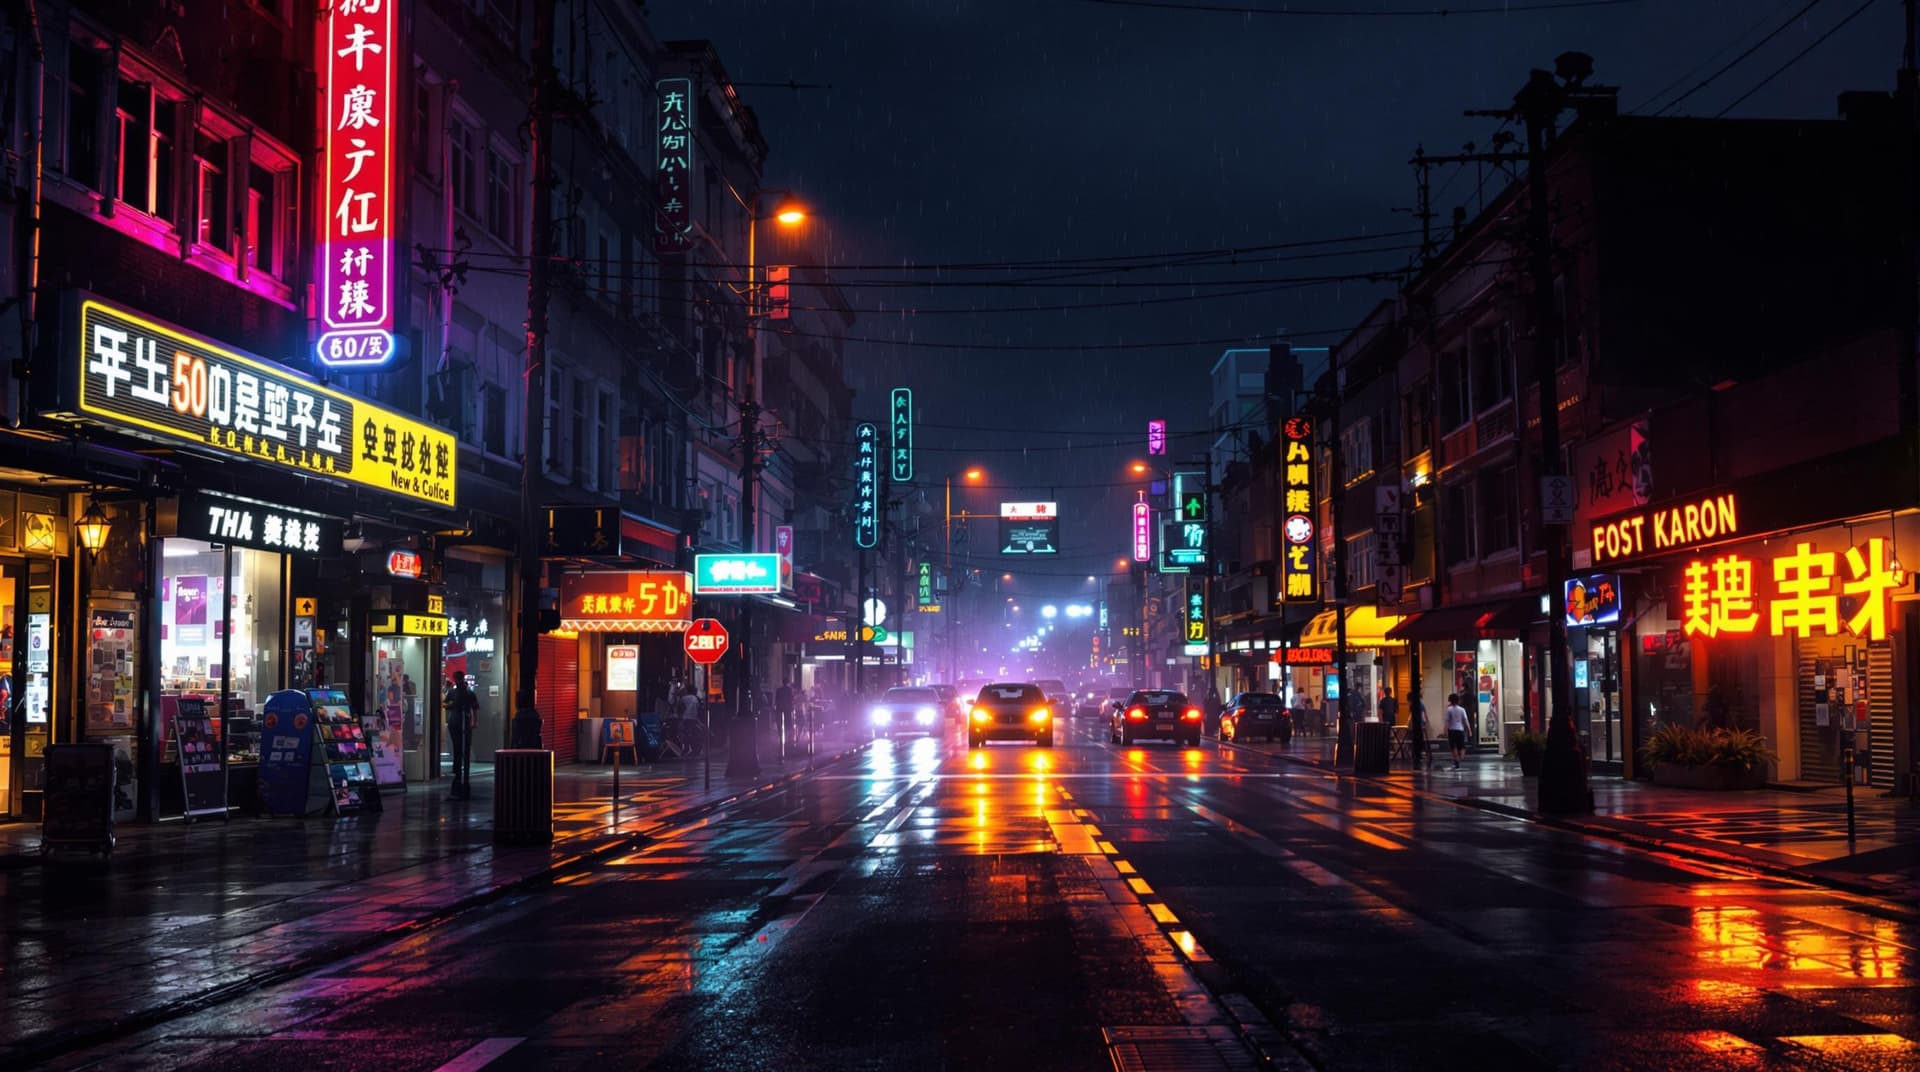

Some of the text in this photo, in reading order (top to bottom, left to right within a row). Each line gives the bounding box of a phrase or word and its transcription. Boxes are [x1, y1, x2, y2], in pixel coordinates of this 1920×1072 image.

[413, 476, 420, 493] &
[1593, 493, 1737, 561] FOST KARON
